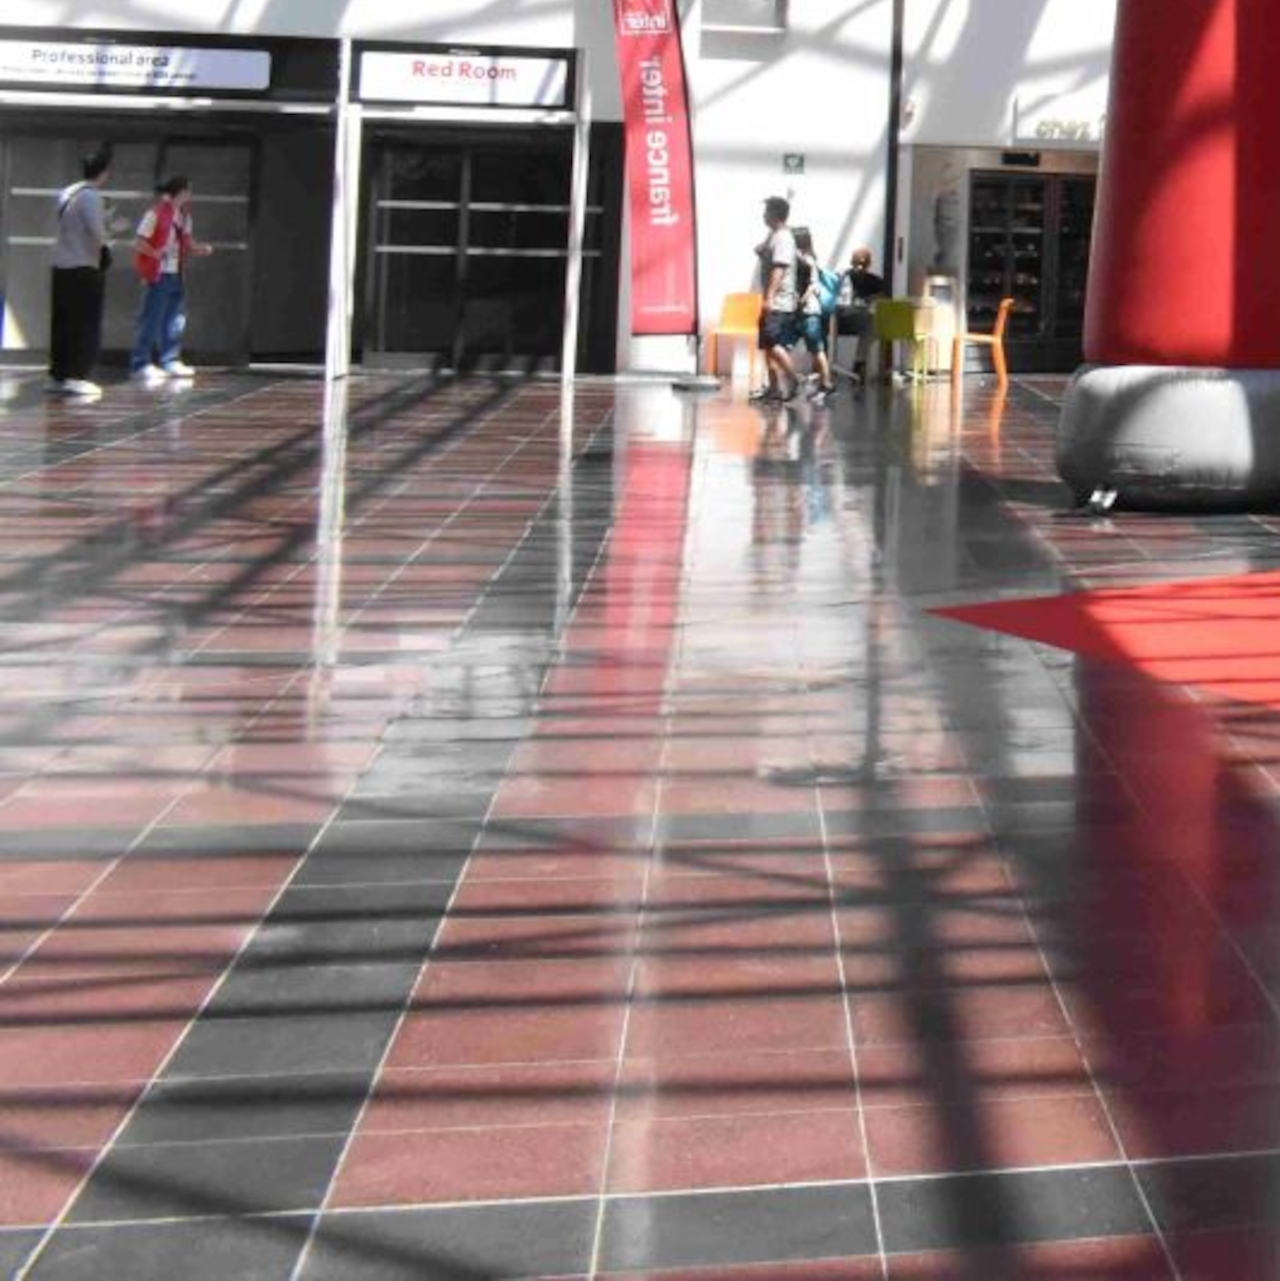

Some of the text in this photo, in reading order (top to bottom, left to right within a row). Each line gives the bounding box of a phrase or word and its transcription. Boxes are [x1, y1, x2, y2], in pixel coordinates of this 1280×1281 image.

[31, 49, 170, 67] Professional area
[412, 60, 517, 81] Red Room
